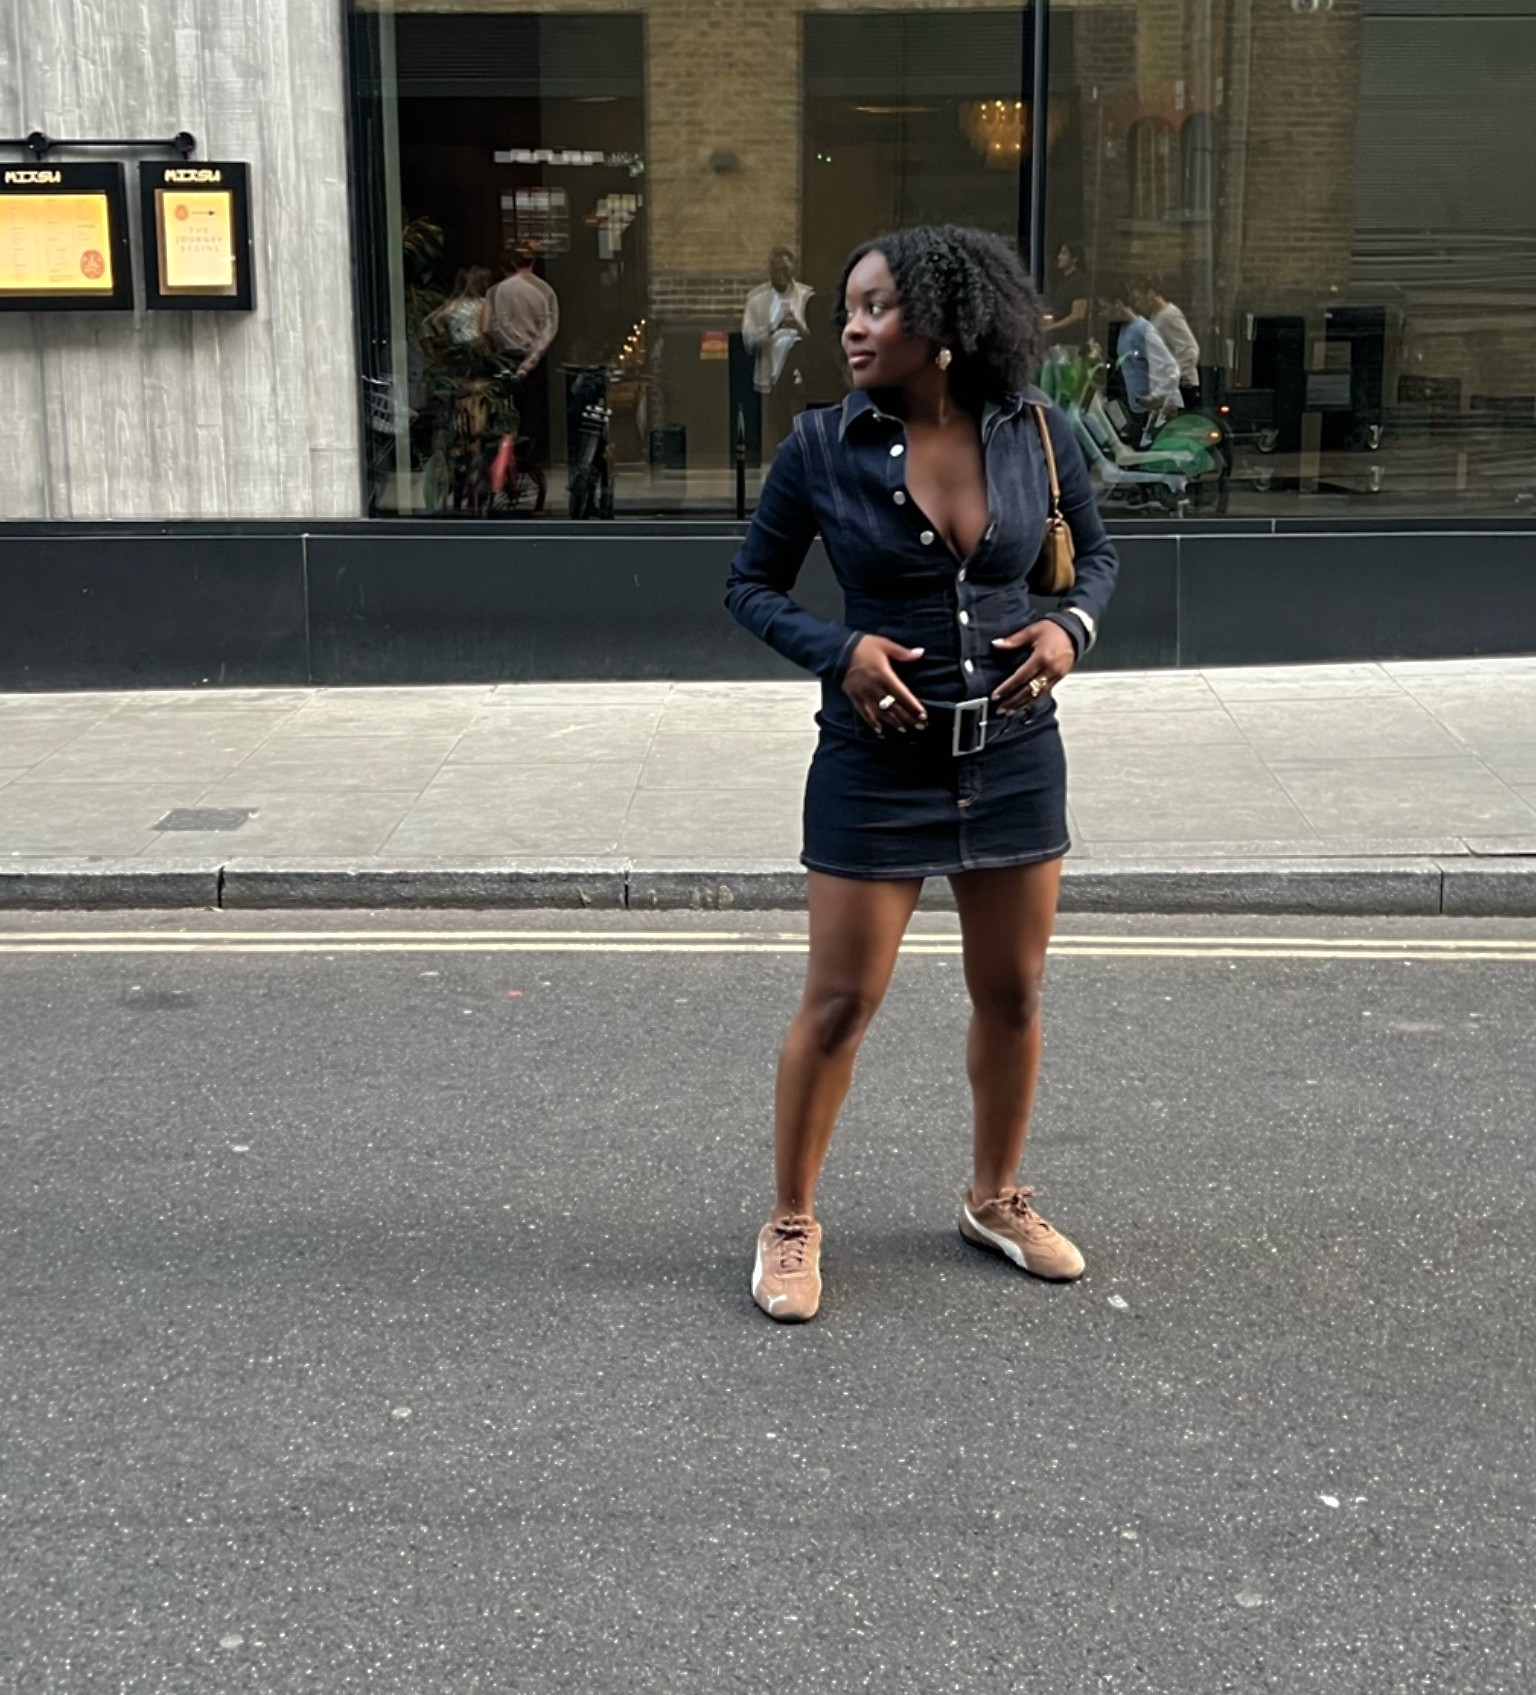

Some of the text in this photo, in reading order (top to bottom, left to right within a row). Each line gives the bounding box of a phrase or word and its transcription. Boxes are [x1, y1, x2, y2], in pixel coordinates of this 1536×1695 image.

[189, 226, 208, 234] THE
[175, 236, 222, 244] JOURNEY
[180, 244, 219, 253] BEGINS
